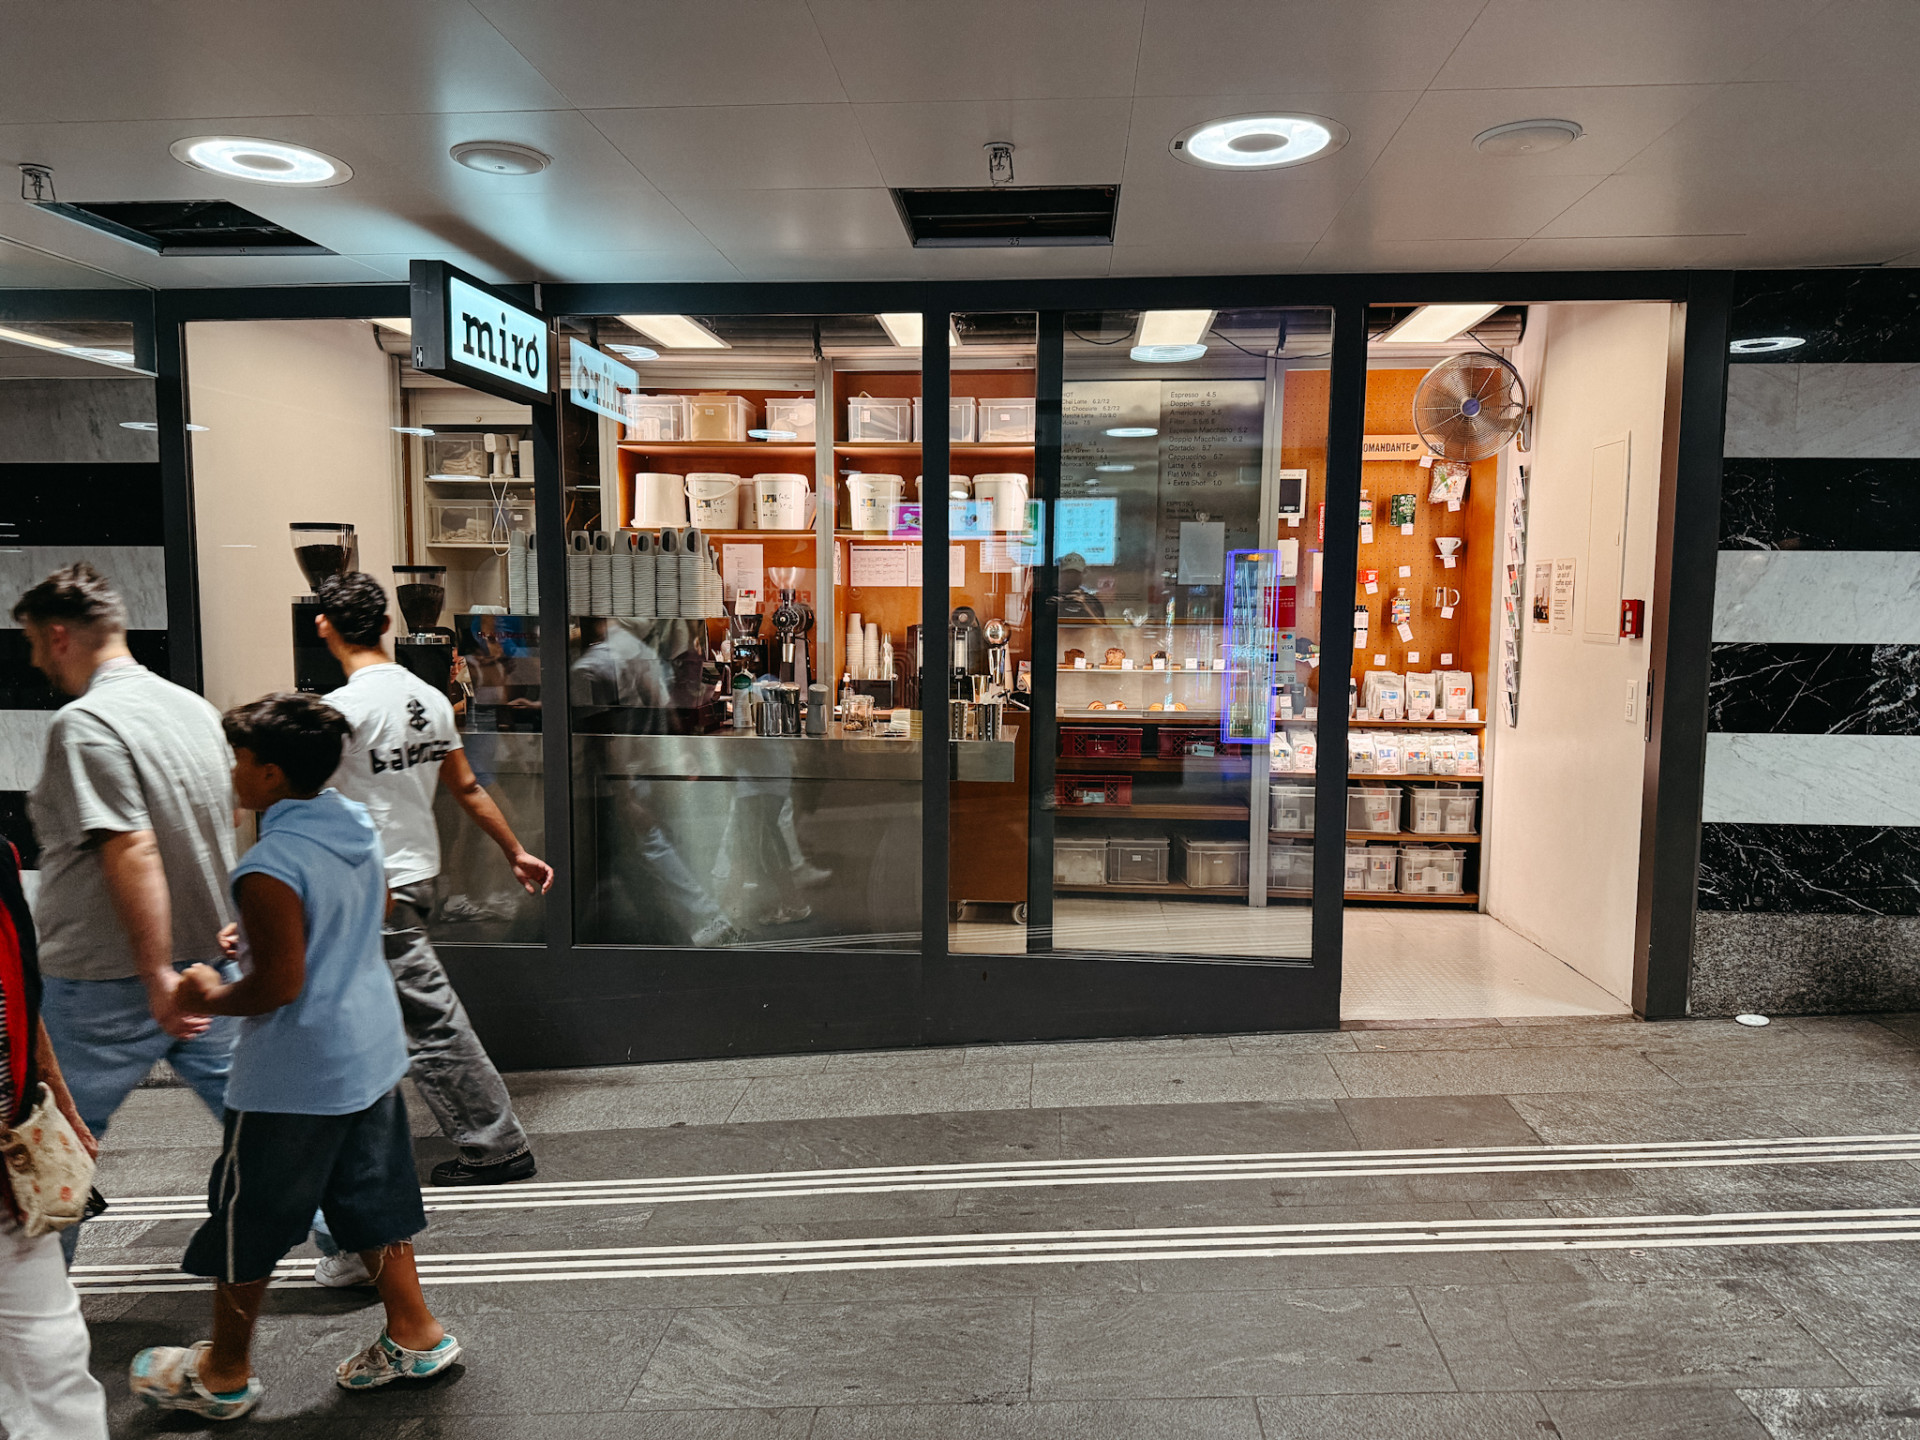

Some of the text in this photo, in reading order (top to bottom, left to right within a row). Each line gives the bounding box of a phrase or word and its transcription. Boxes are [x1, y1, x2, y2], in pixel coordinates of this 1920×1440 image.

[462, 311, 540, 379] miró
[1363, 442, 1410, 452] OMANDANTE
[1168, 453, 1207, 461] Cappuccino
